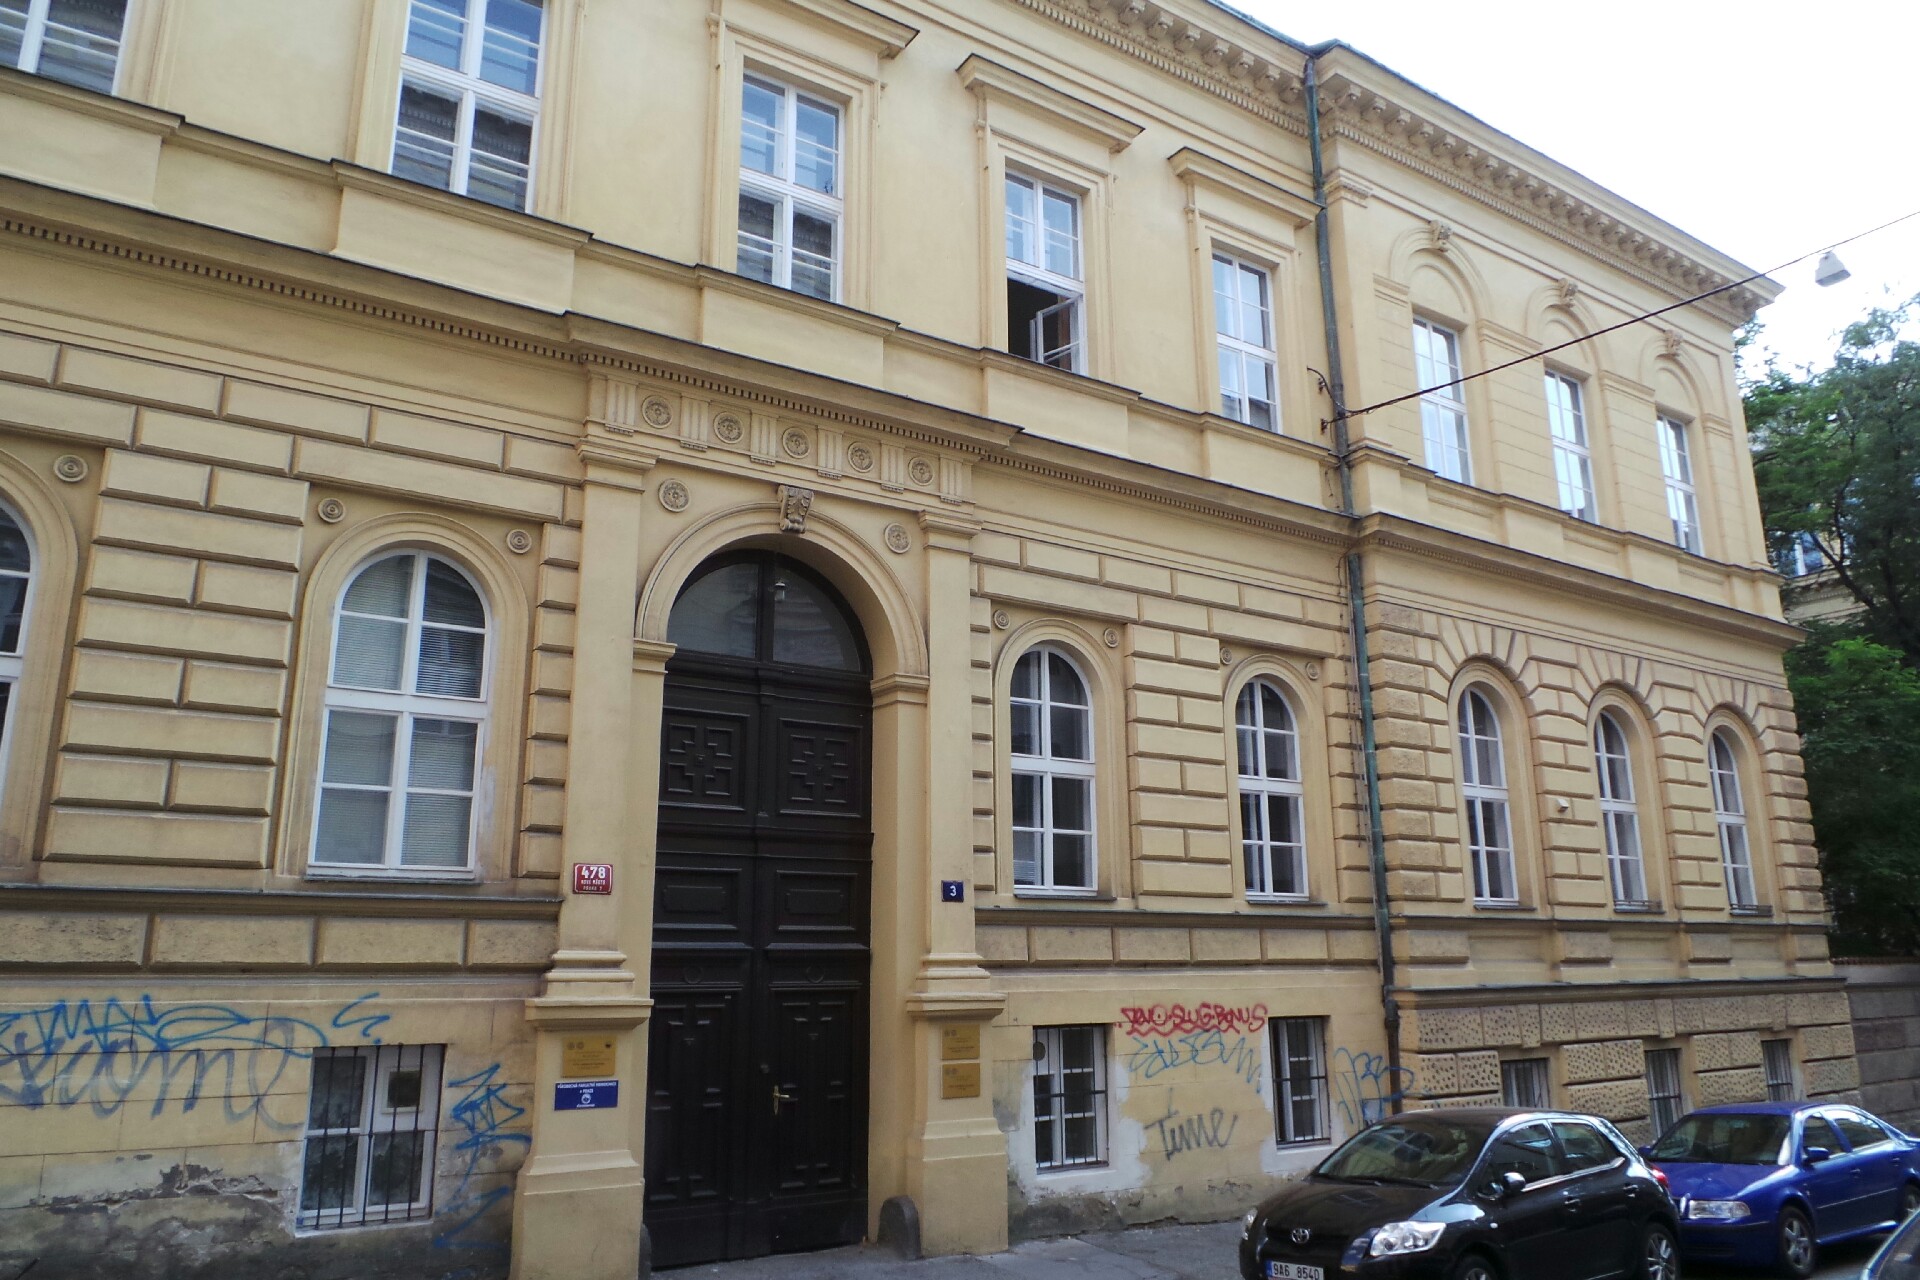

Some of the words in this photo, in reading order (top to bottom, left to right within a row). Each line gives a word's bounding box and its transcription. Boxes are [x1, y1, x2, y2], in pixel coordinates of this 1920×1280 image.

[581, 866, 606, 879] 478
[949, 885, 957, 897] 3
[1273, 1263, 1290, 1277] 9A6
[1296, 1266, 1320, 1280] 8540
